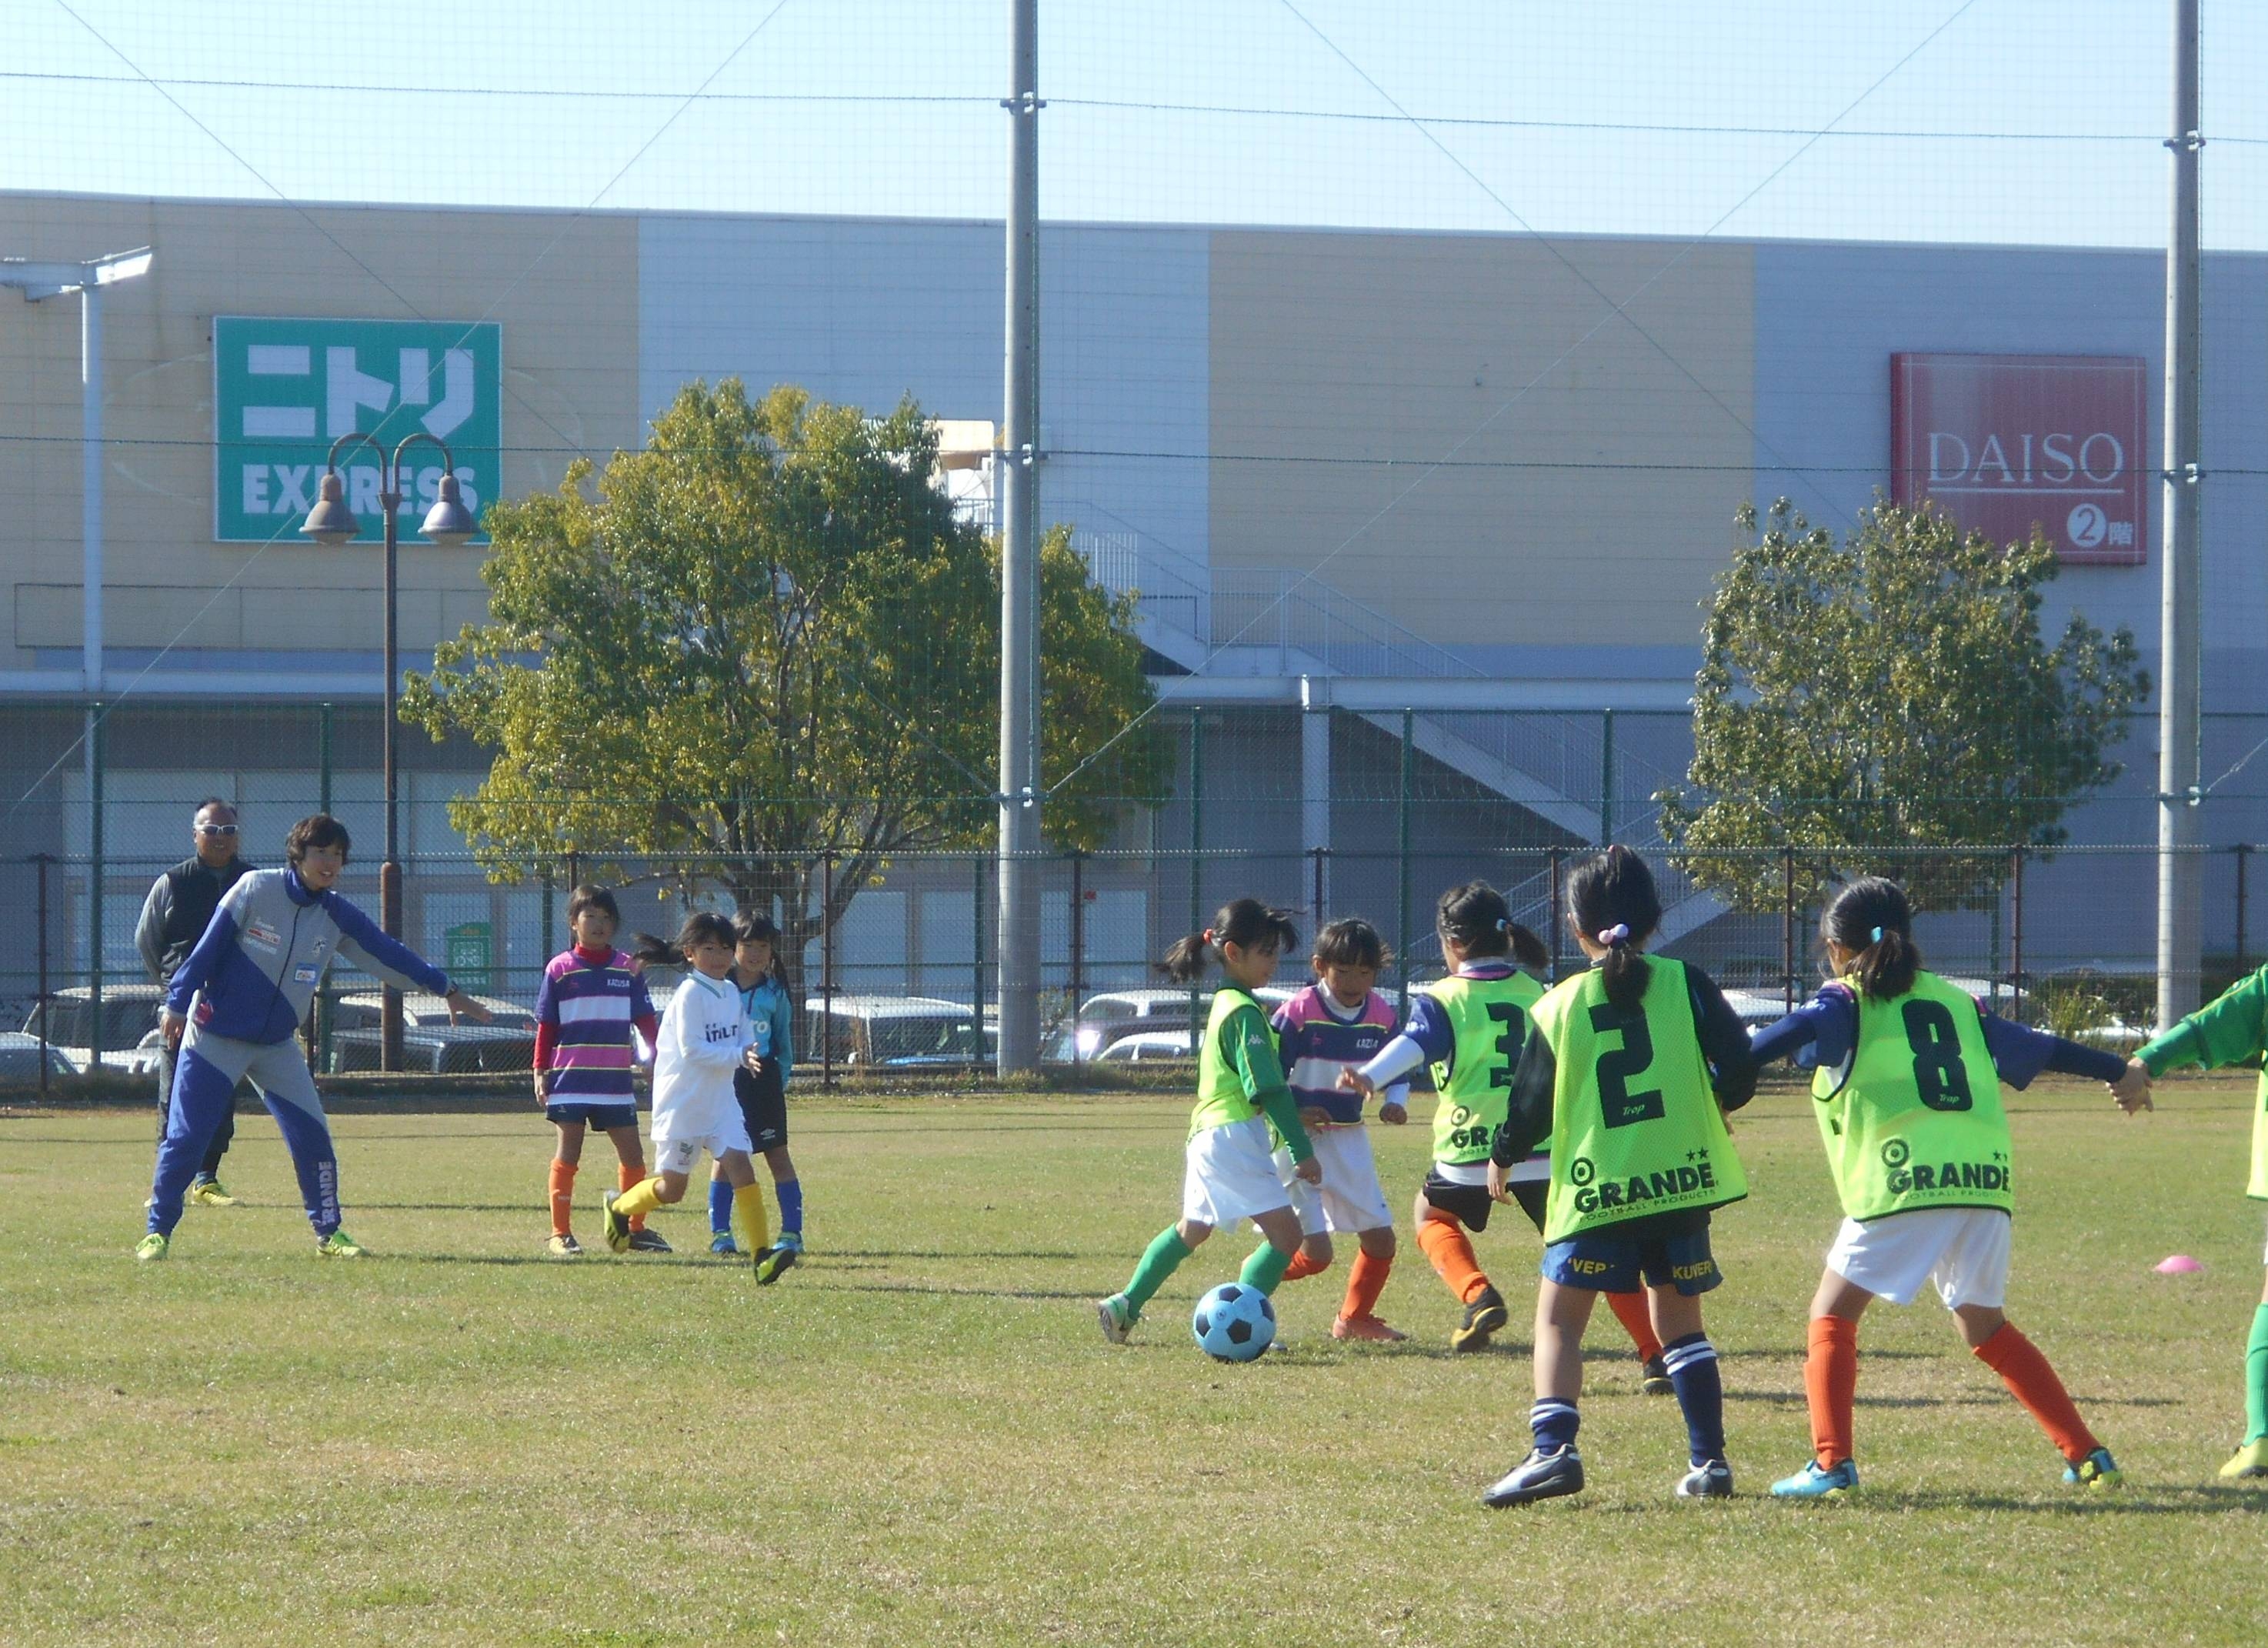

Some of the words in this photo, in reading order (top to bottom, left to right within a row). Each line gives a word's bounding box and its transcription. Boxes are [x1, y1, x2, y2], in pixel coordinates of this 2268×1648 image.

[243, 344, 475, 439] ニトリ
[1928, 432, 2125, 484] DAISO
[1484, 1002, 1526, 1088] 3
[1589, 1000, 1666, 1129] 2
[1901, 999, 1973, 1112] 8
[1574, 1162, 1716, 1213] GRANDE
